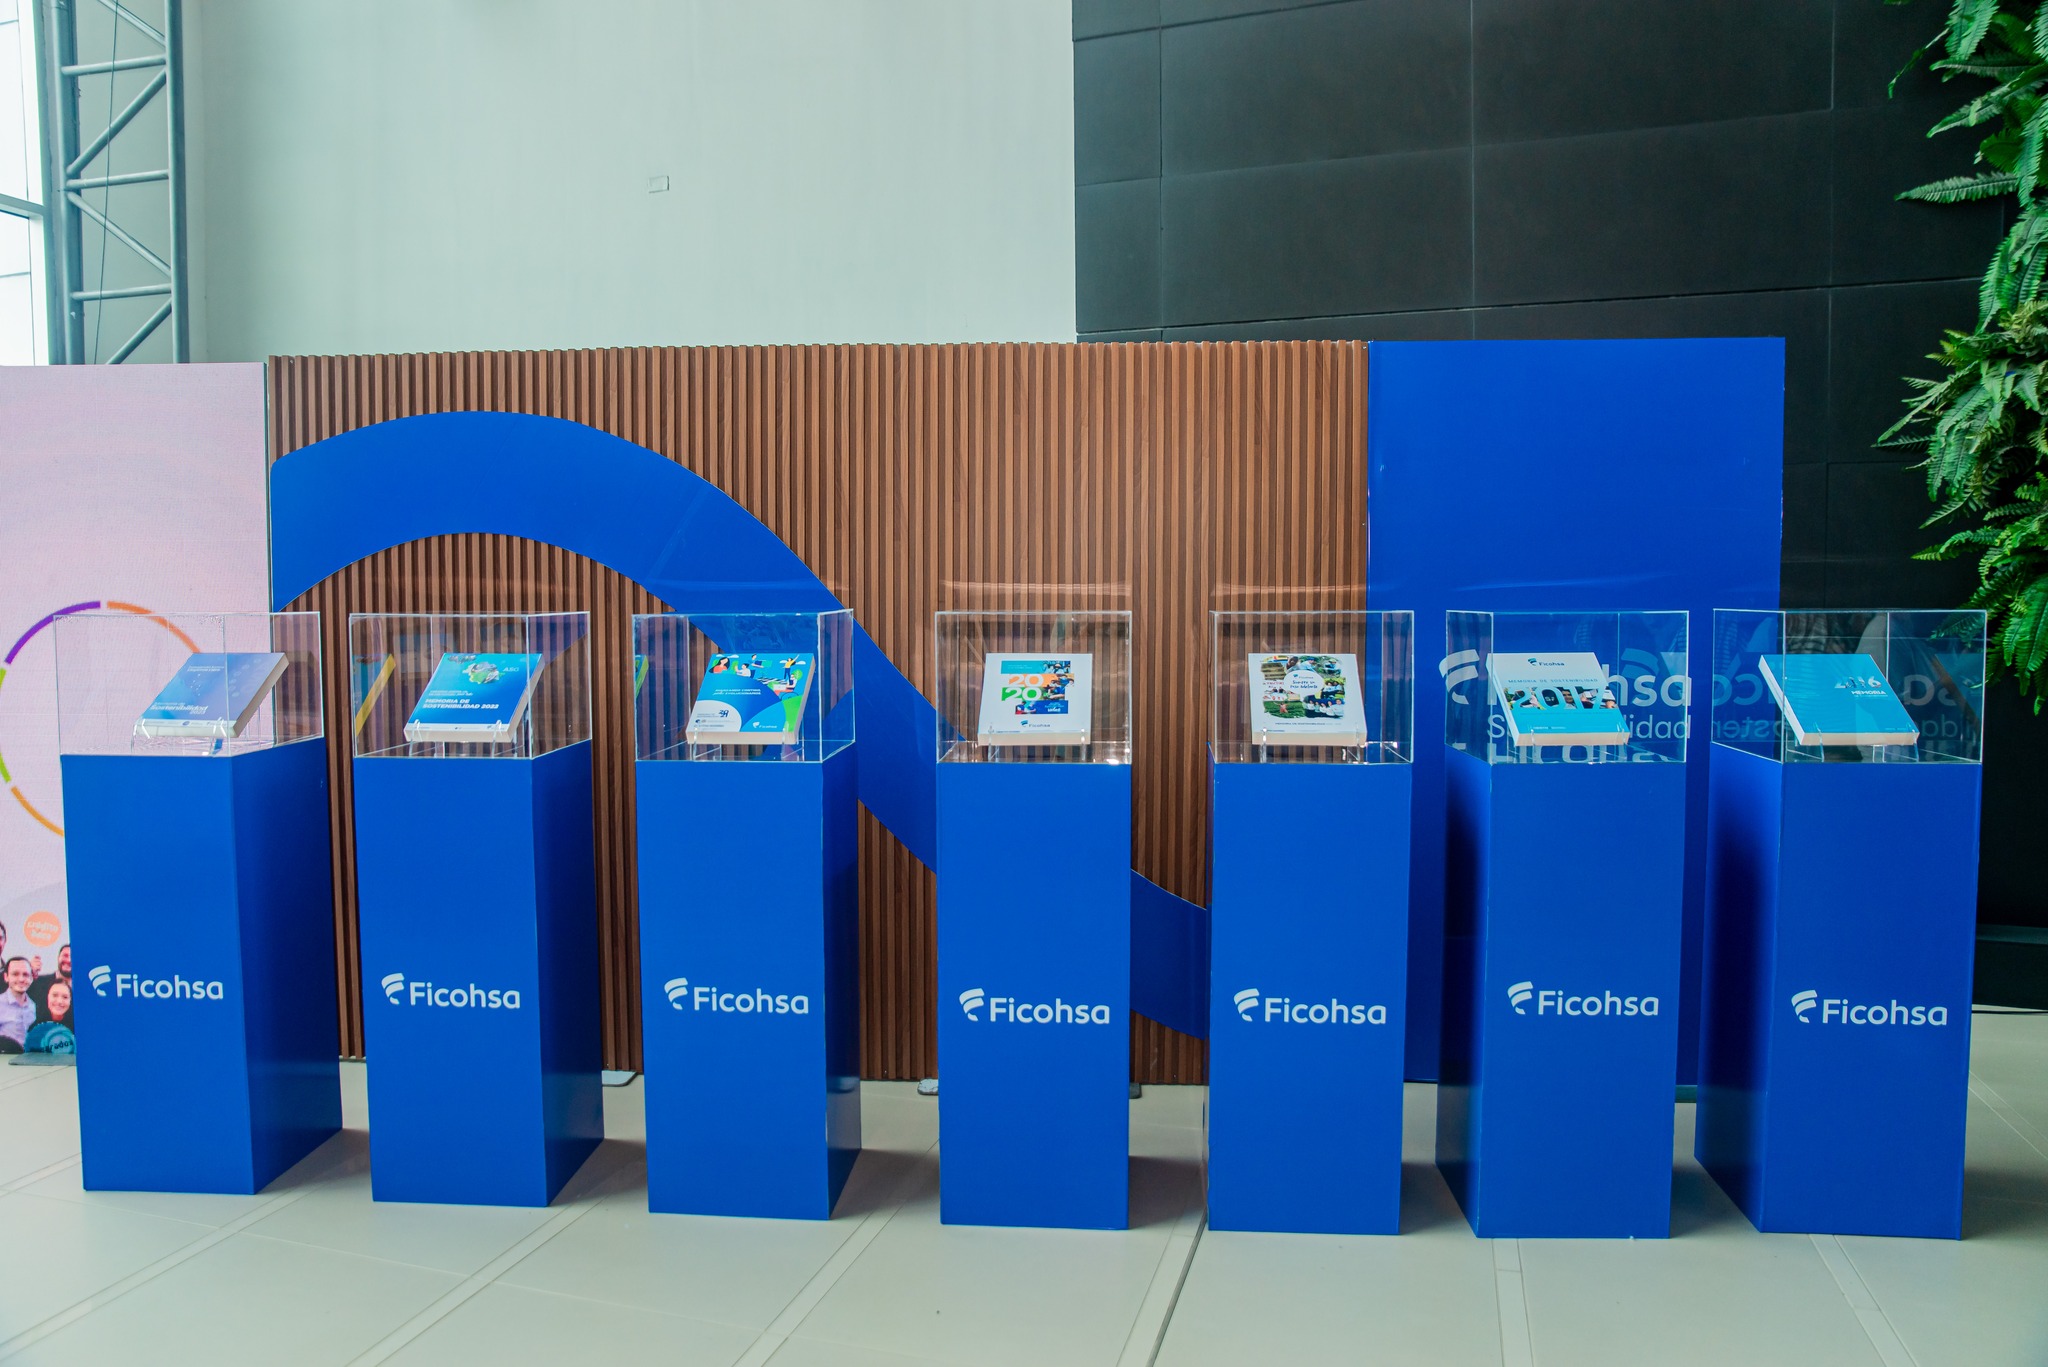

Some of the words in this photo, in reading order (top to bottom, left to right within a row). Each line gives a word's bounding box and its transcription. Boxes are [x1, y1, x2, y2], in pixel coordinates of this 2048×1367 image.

[1008, 674, 1044, 687] 20
[1005, 687, 1042, 701] 20
[1508, 687, 1604, 709] 2017
[117, 975, 223, 999] Ficohsa
[410, 983, 519, 1008] Ficohsa
[694, 988, 808, 1013] Ficohsa
[991, 998, 1109, 1024] Ficohsa
[1265, 998, 1386, 1024] Ficohsa
[1539, 991, 1658, 1015] Ficohsa
[1823, 1000, 1947, 1025] Ficohsa
